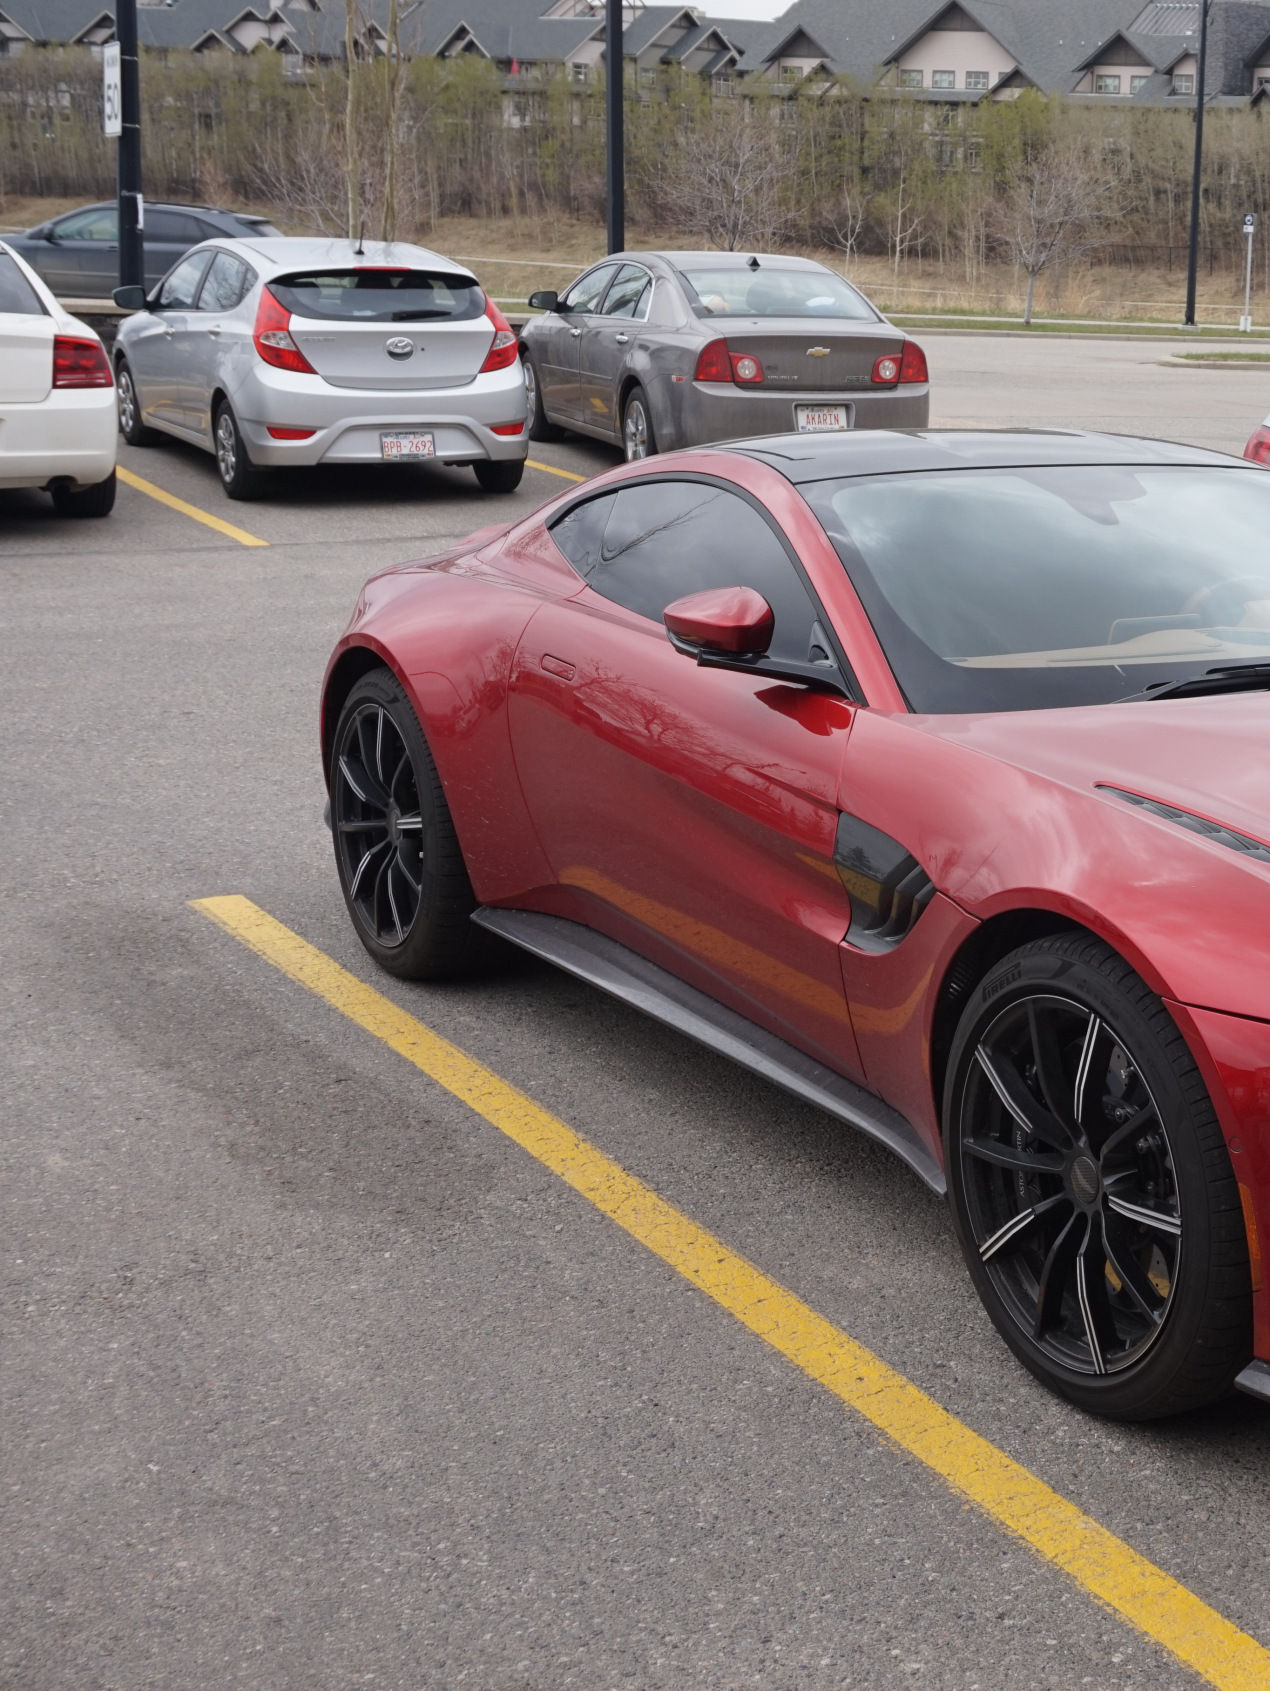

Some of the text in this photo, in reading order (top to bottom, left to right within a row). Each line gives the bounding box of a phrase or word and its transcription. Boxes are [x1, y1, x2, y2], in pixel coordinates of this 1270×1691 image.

[106, 83, 119, 122] 50
[806, 413, 839, 426] AKARIN
[383, 440, 433, 453] BPB-2692
[982, 961, 1022, 1004] PIRELLI
